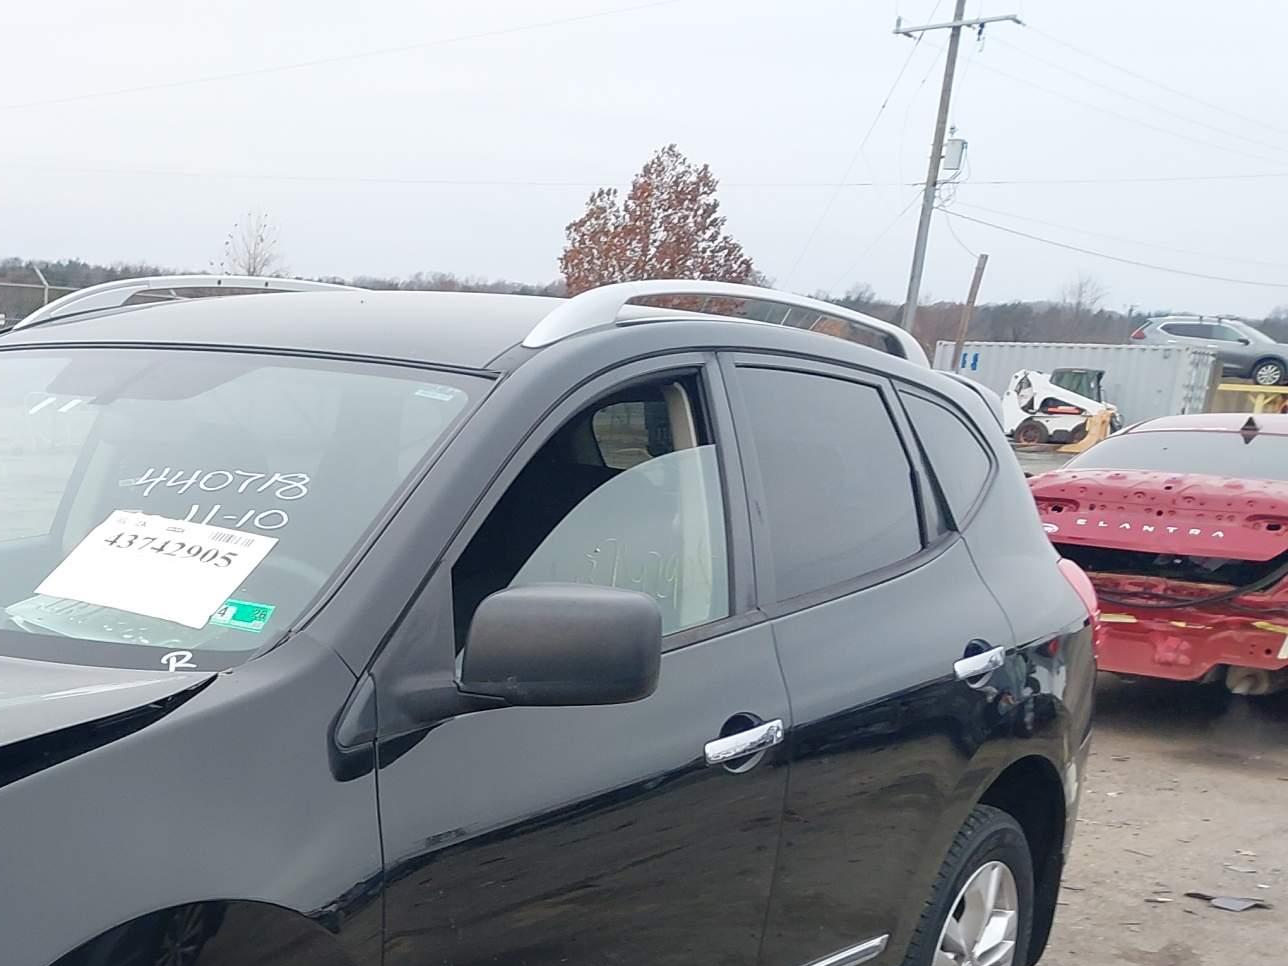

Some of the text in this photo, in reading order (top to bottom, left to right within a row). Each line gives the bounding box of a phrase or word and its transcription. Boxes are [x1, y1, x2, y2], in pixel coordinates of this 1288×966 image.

[133, 467, 311, 500] 440718
[1075, 518, 1225, 539] ELANTRA
[103, 531, 239, 568] 43742905
[160, 650, 198, 673] R
